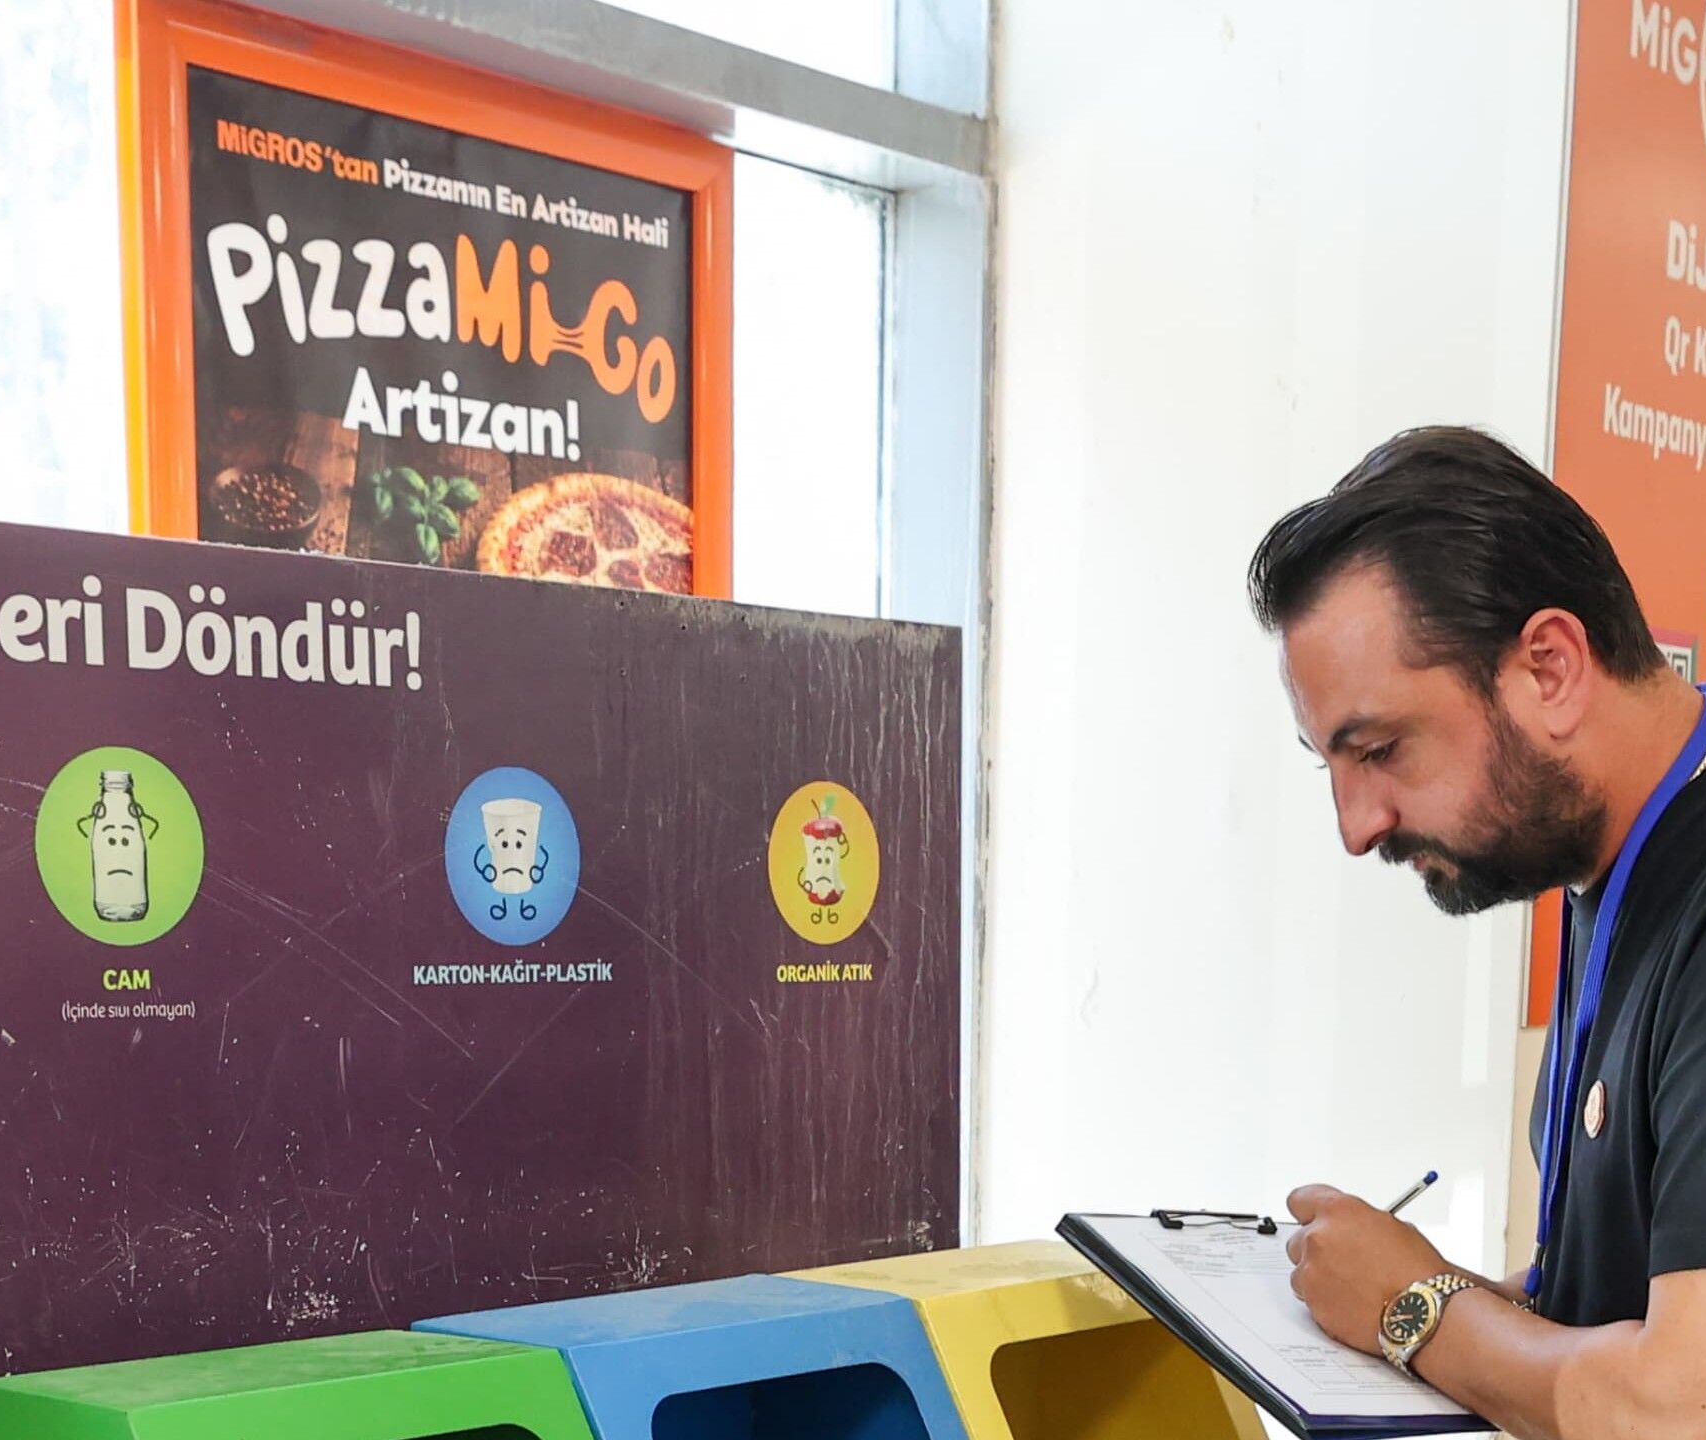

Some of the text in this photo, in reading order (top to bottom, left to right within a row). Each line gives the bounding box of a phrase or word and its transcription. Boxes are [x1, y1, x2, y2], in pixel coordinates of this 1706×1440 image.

[384, 159, 492, 210] Pizzanın
[495, 186, 527, 219] En
[531, 195, 618, 238] Artizan
[623, 212, 669, 249] Hali
[1664, 316, 1690, 375] Qr
[341, 366, 581, 461] Artizan!
[125, 587, 423, 690] Döndür!
[103, 968, 151, 991] CAM
[413, 958, 613, 985] KARTON-KAĞIT-PLASTİK
[776, 960, 873, 982] ORGANİK ATIK
[132, 1000, 197, 1022] olmayan)
